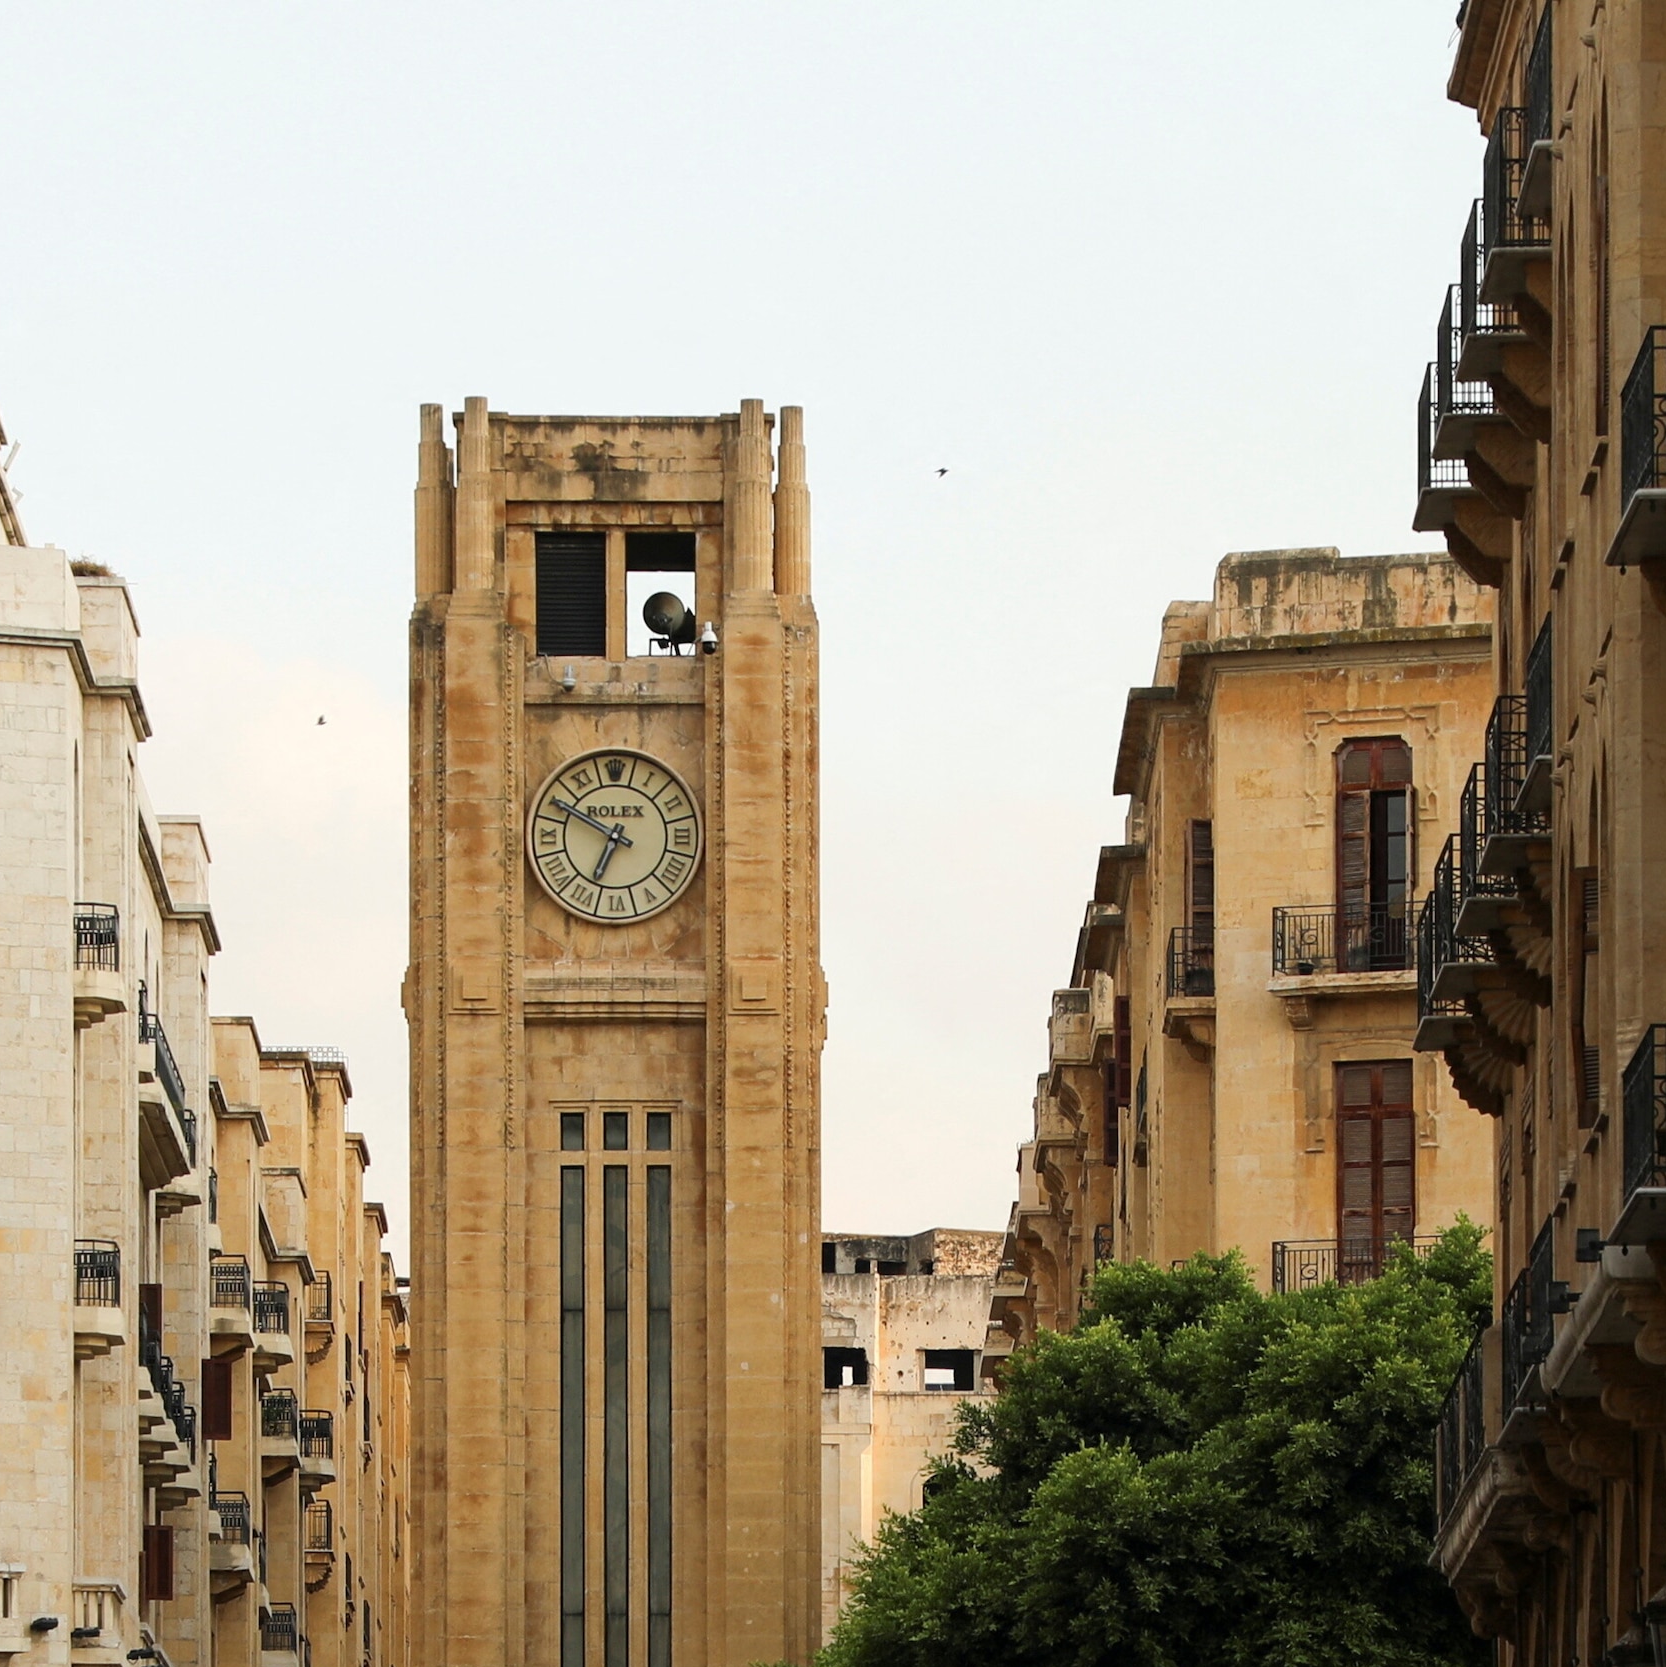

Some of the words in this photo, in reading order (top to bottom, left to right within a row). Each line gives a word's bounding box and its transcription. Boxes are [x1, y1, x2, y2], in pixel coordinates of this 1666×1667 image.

[643, 771, 655, 787] I
[586, 805, 645, 818] ROLEX
[664, 794, 683, 812] II
[674, 827, 690, 846] III
